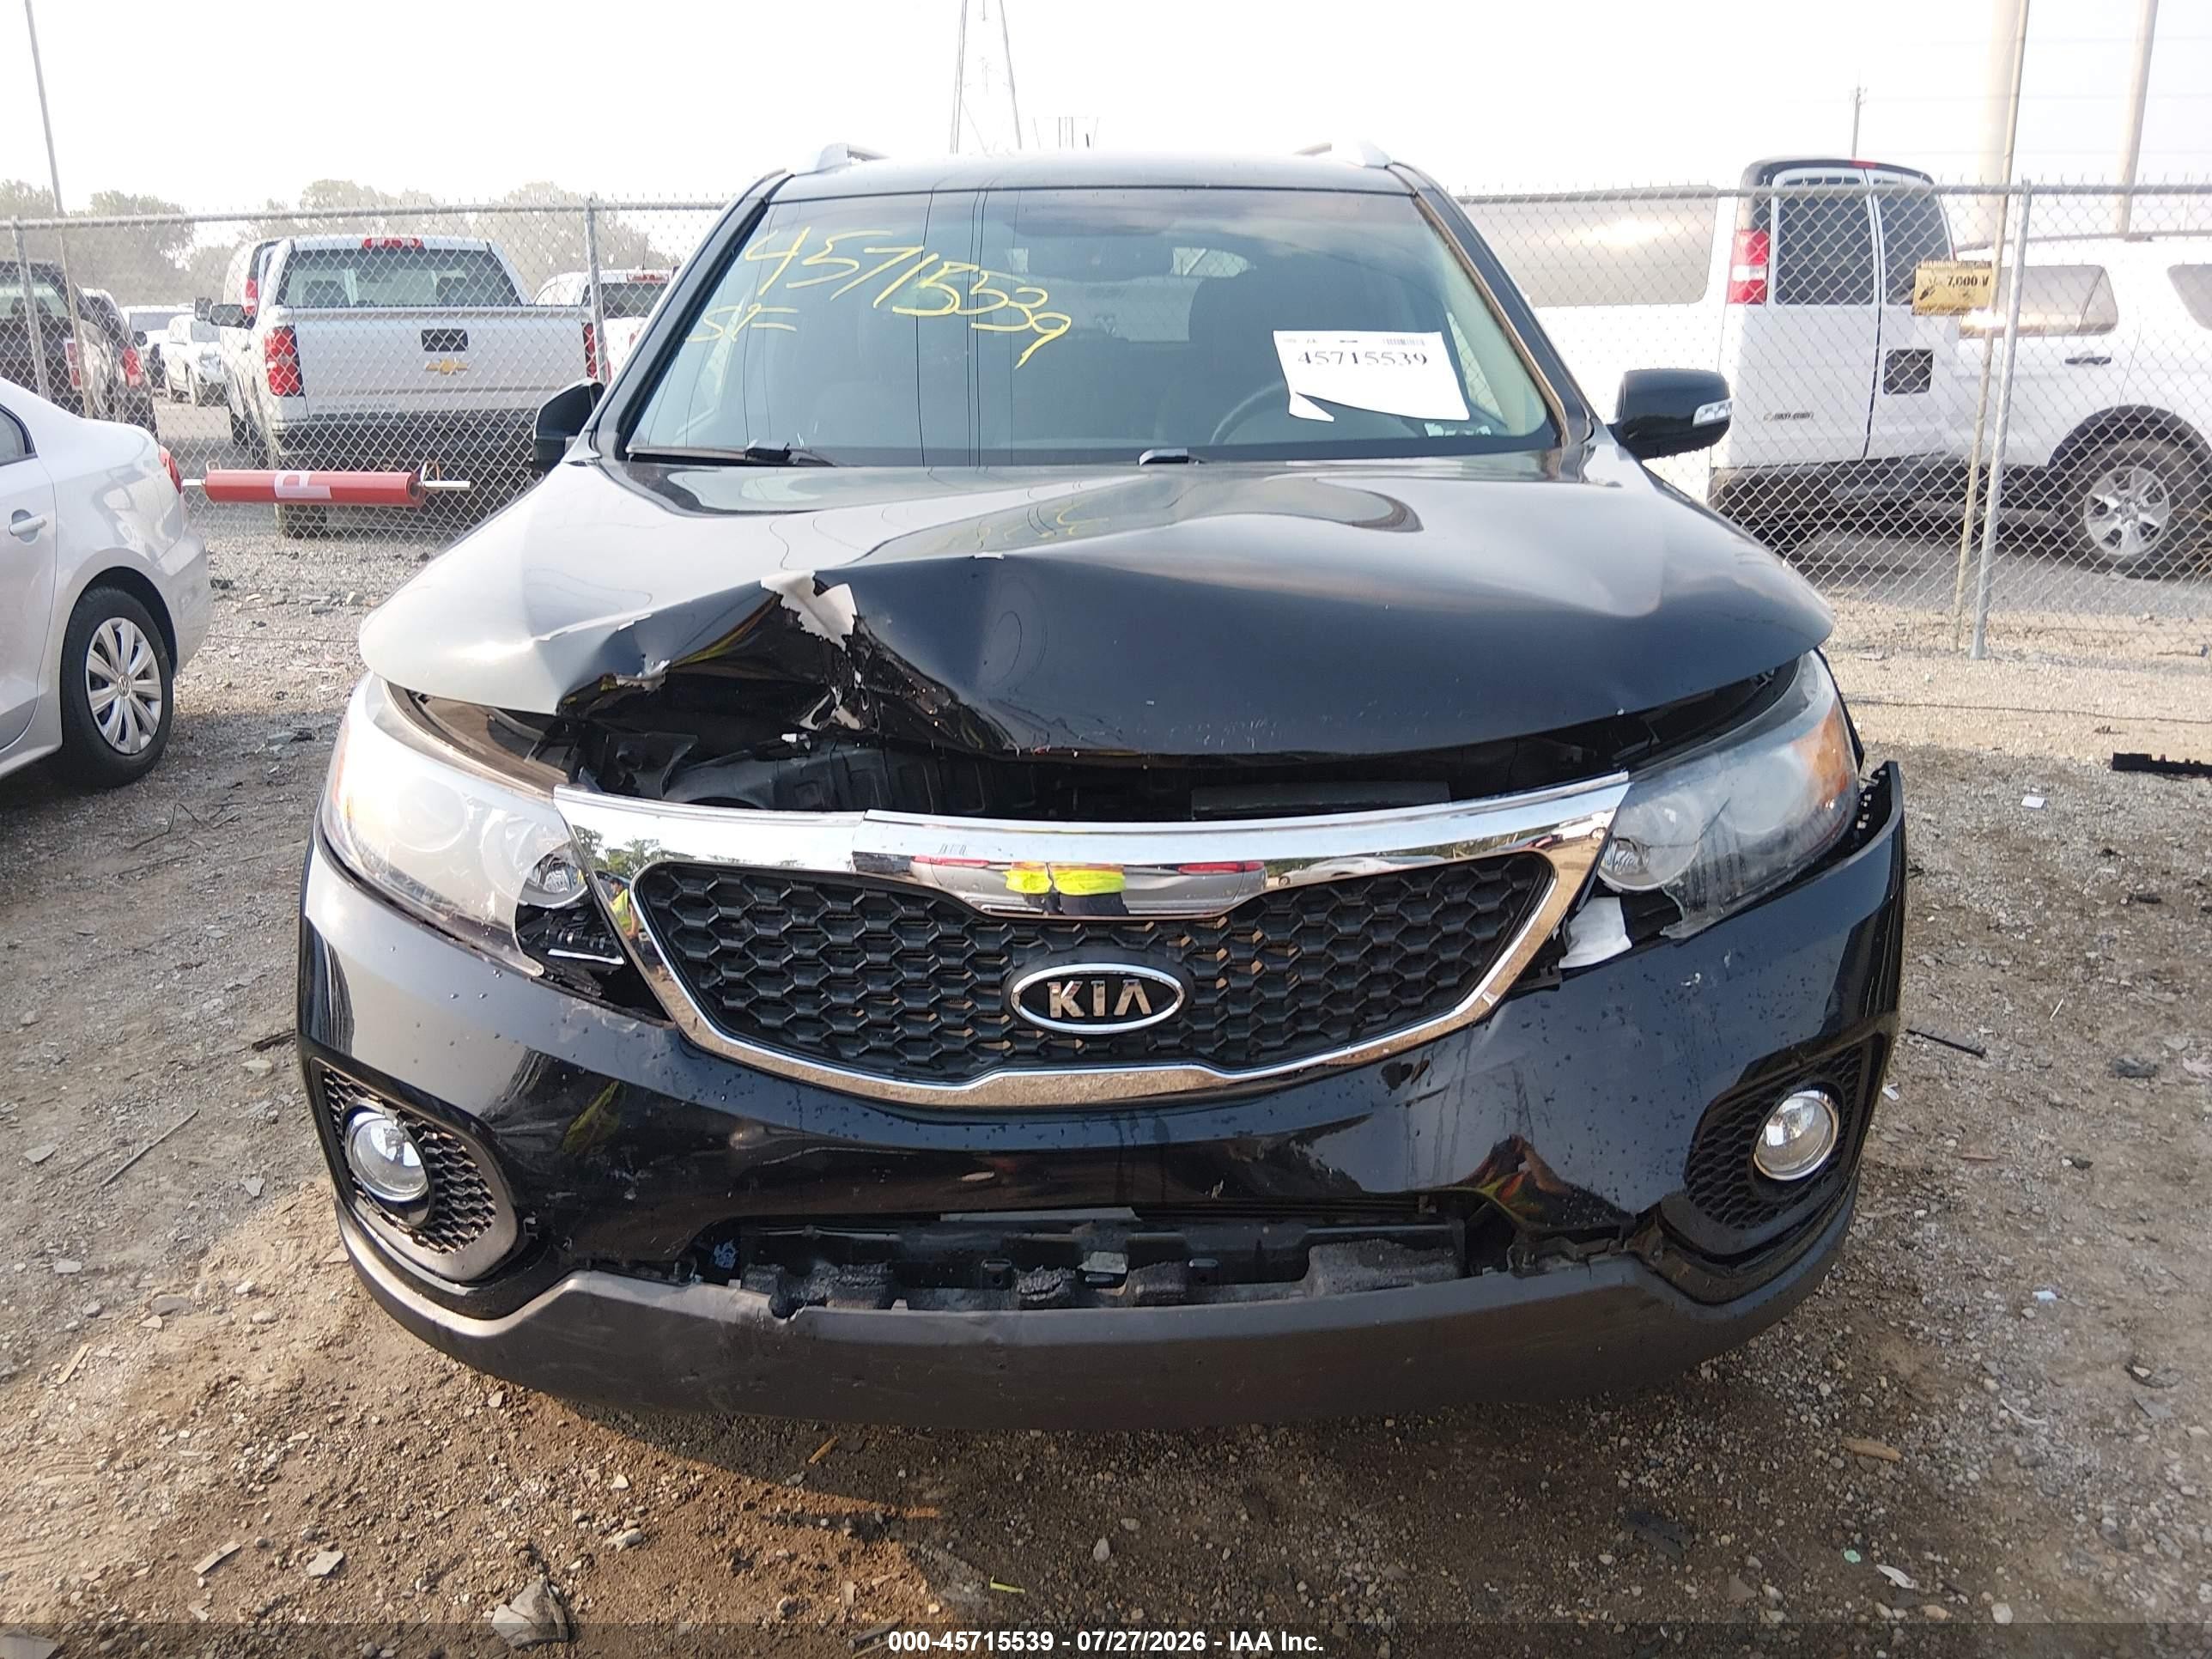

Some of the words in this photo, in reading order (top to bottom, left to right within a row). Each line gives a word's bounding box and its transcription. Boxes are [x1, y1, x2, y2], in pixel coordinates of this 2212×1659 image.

[744, 226, 1072, 370] 45715539
[1297, 350, 1428, 366] 45715539
[1047, 978, 1152, 1018] KIA
